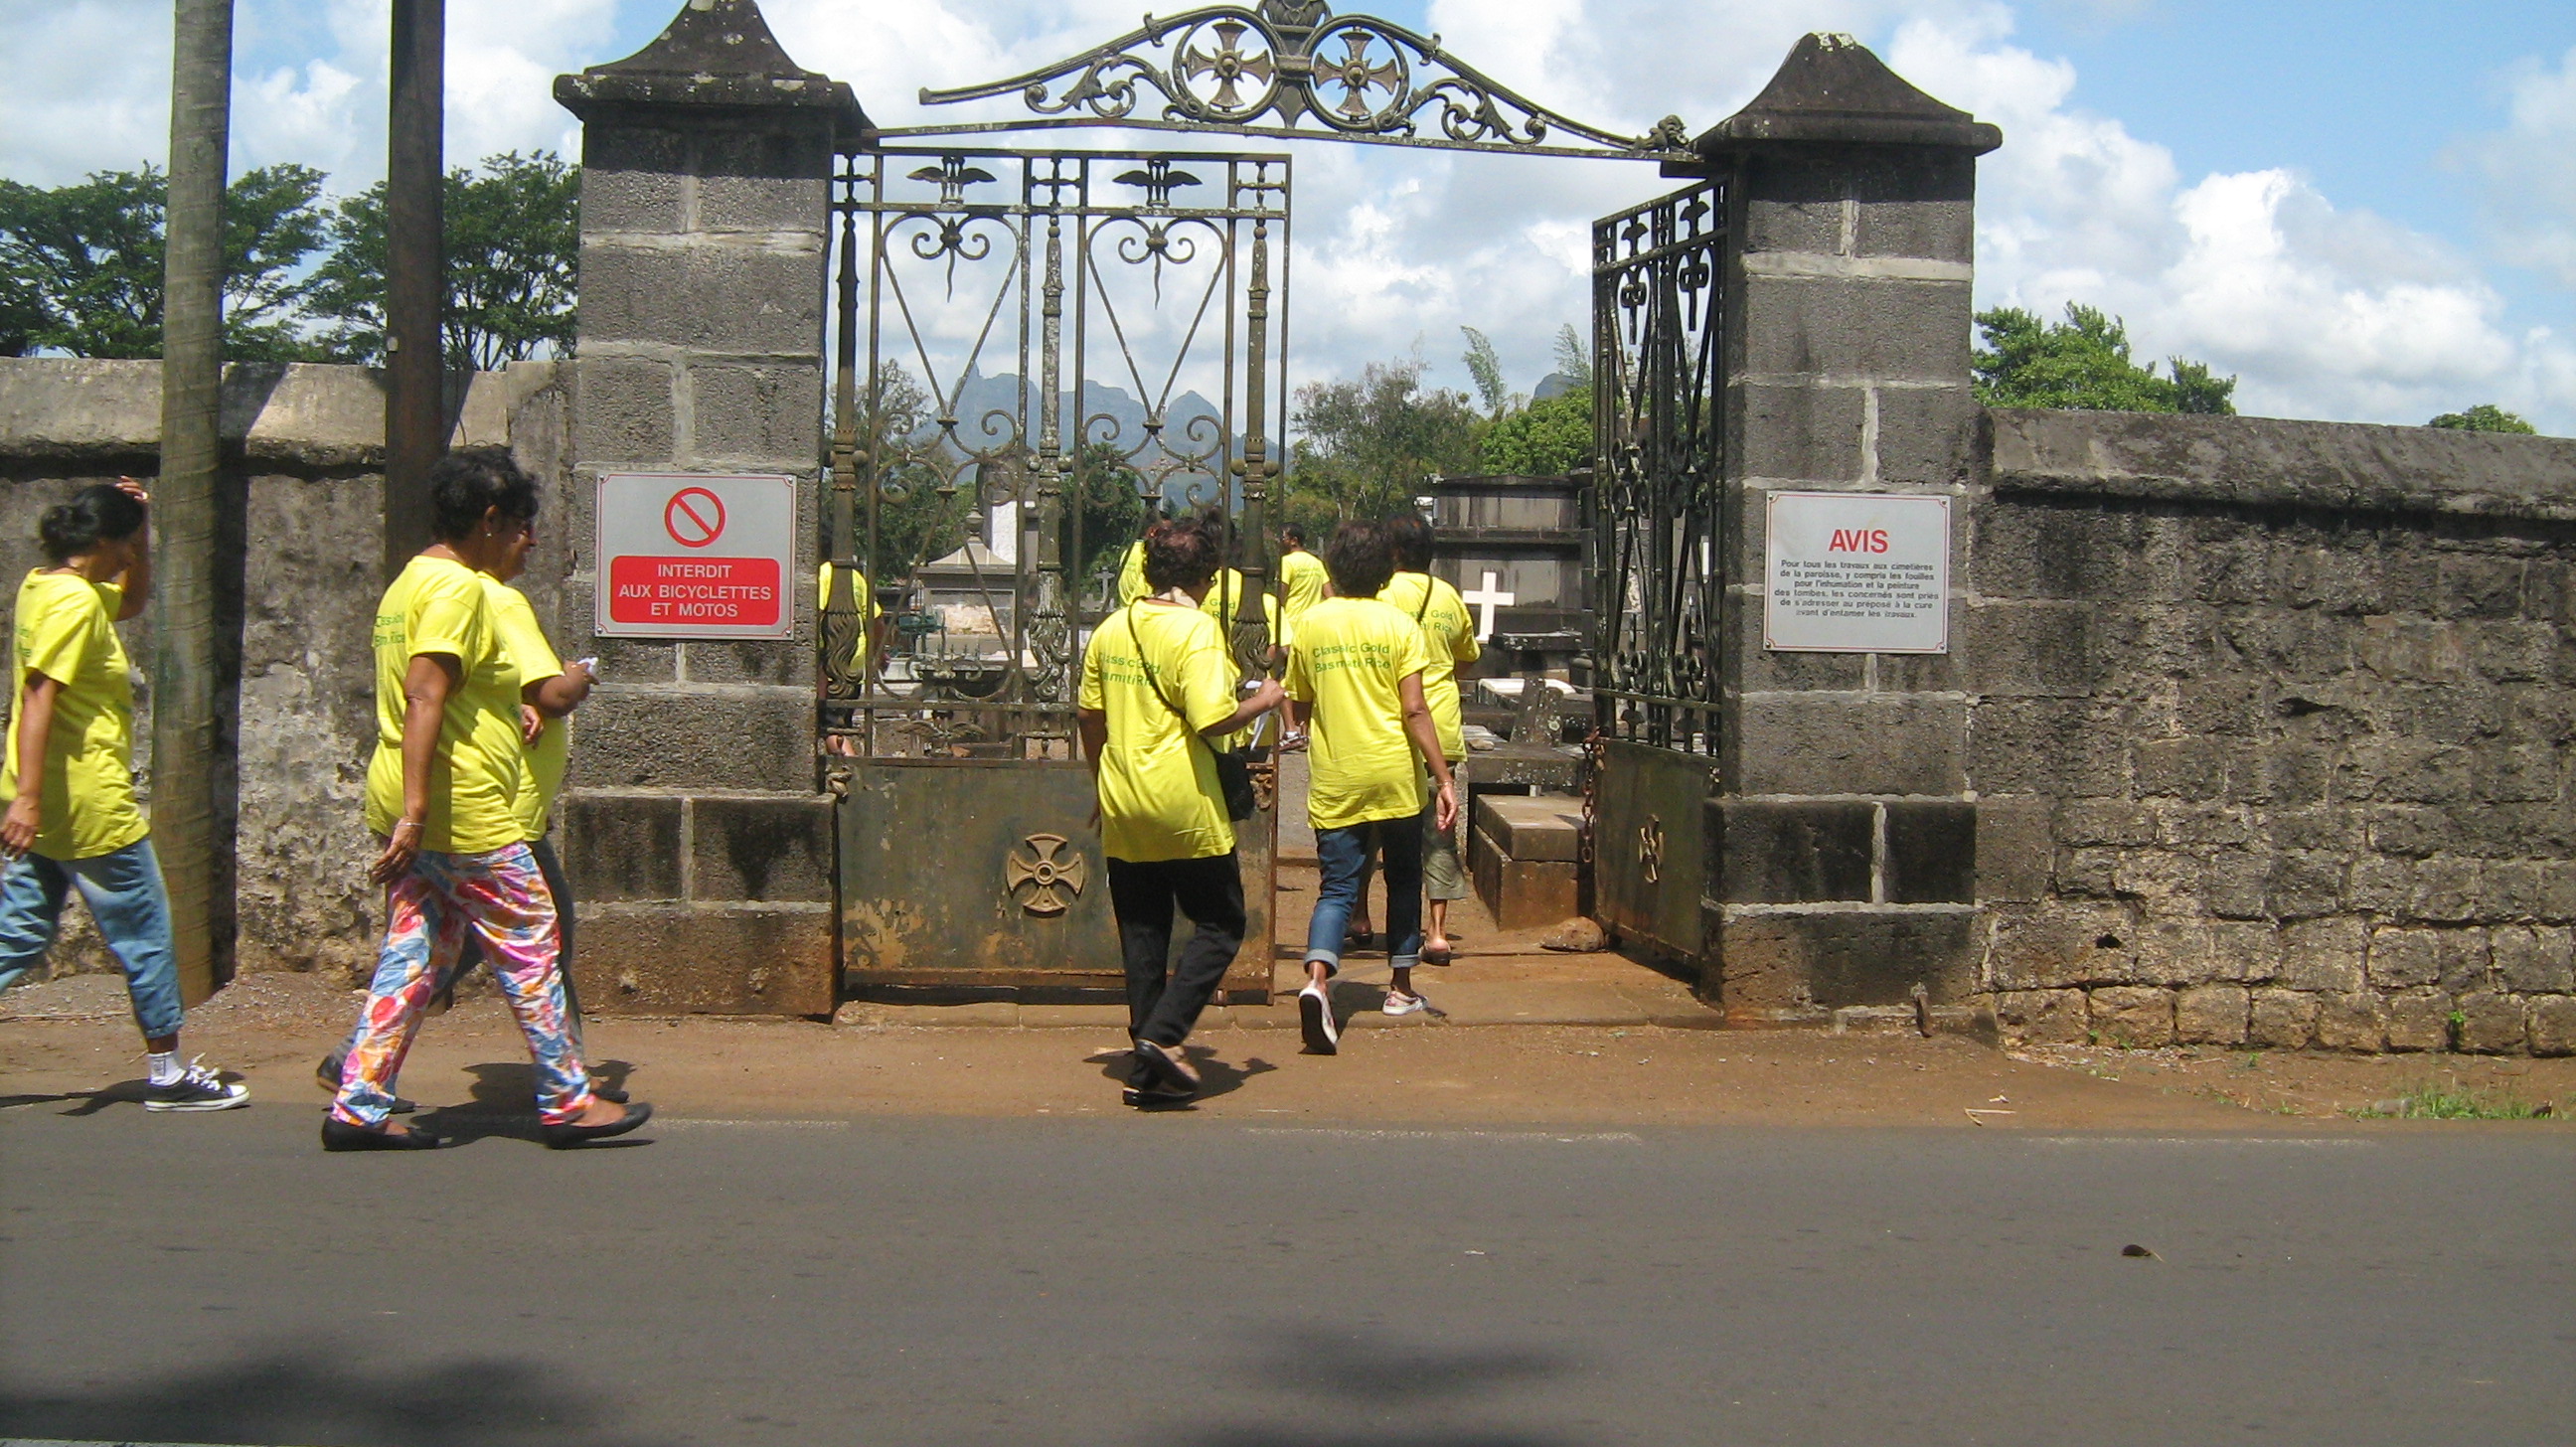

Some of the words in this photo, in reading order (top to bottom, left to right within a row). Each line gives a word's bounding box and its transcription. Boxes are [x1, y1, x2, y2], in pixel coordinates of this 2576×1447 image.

[1829, 529, 1889, 554] AVIS
[658, 564, 732, 578] INTERDIT
[618, 584, 652, 598] AUX
[658, 584, 771, 600] BICYCLETTES
[651, 602, 672, 616] ET
[678, 603, 738, 617] MOTOS
[1313, 644, 1357, 658] Classic
[1361, 642, 1389, 654] Gold
[1315, 659, 1361, 672] Basmati
[1366, 657, 1390, 669] Rice
